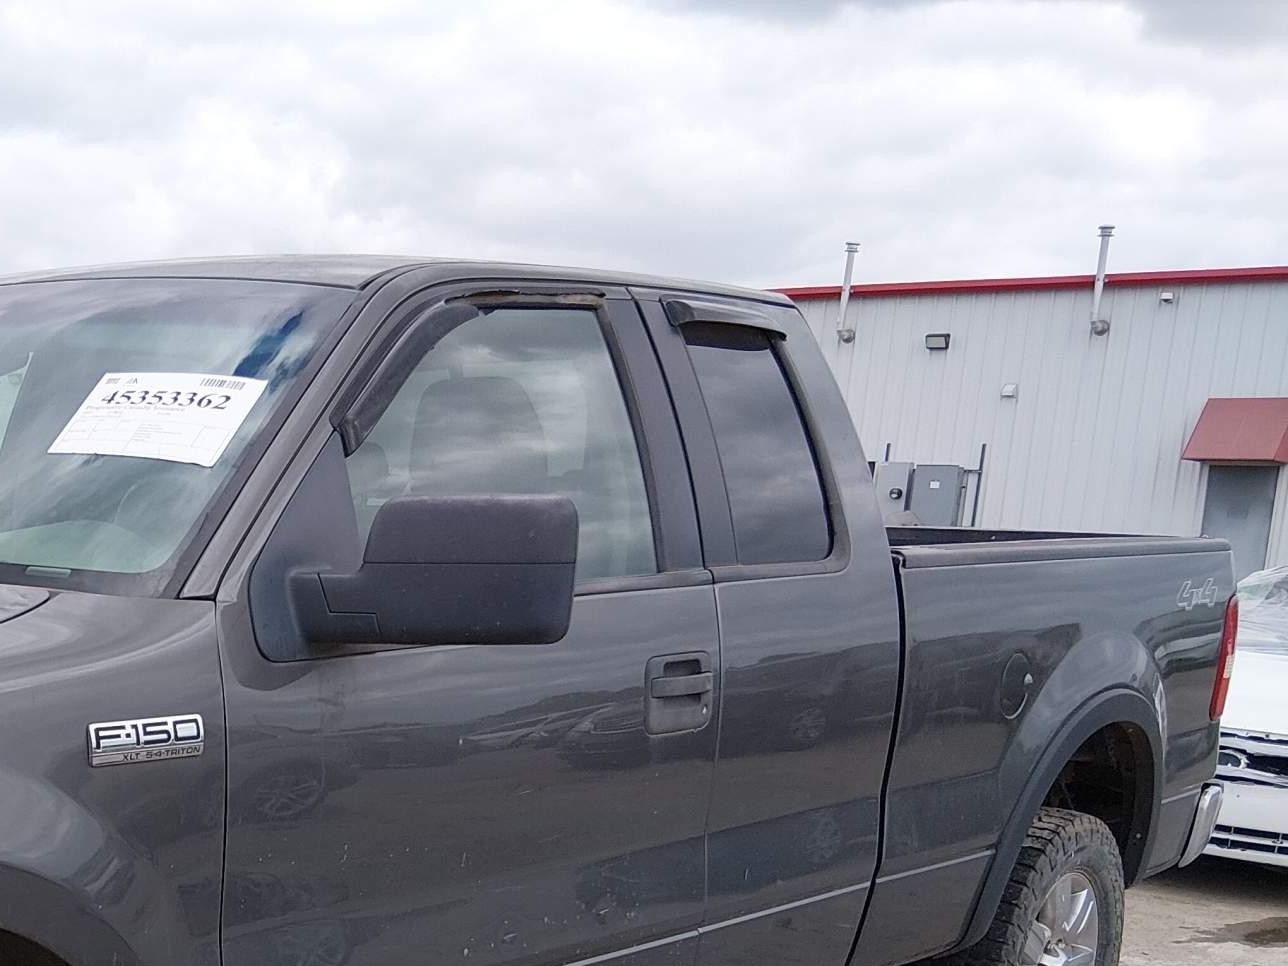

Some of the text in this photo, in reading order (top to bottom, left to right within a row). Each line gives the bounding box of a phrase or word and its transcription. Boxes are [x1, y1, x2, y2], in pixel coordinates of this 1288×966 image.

[101, 390, 231, 410] 45353362
[1176, 578, 1217, 611] 4x4
[122, 752, 141, 761] XLT
